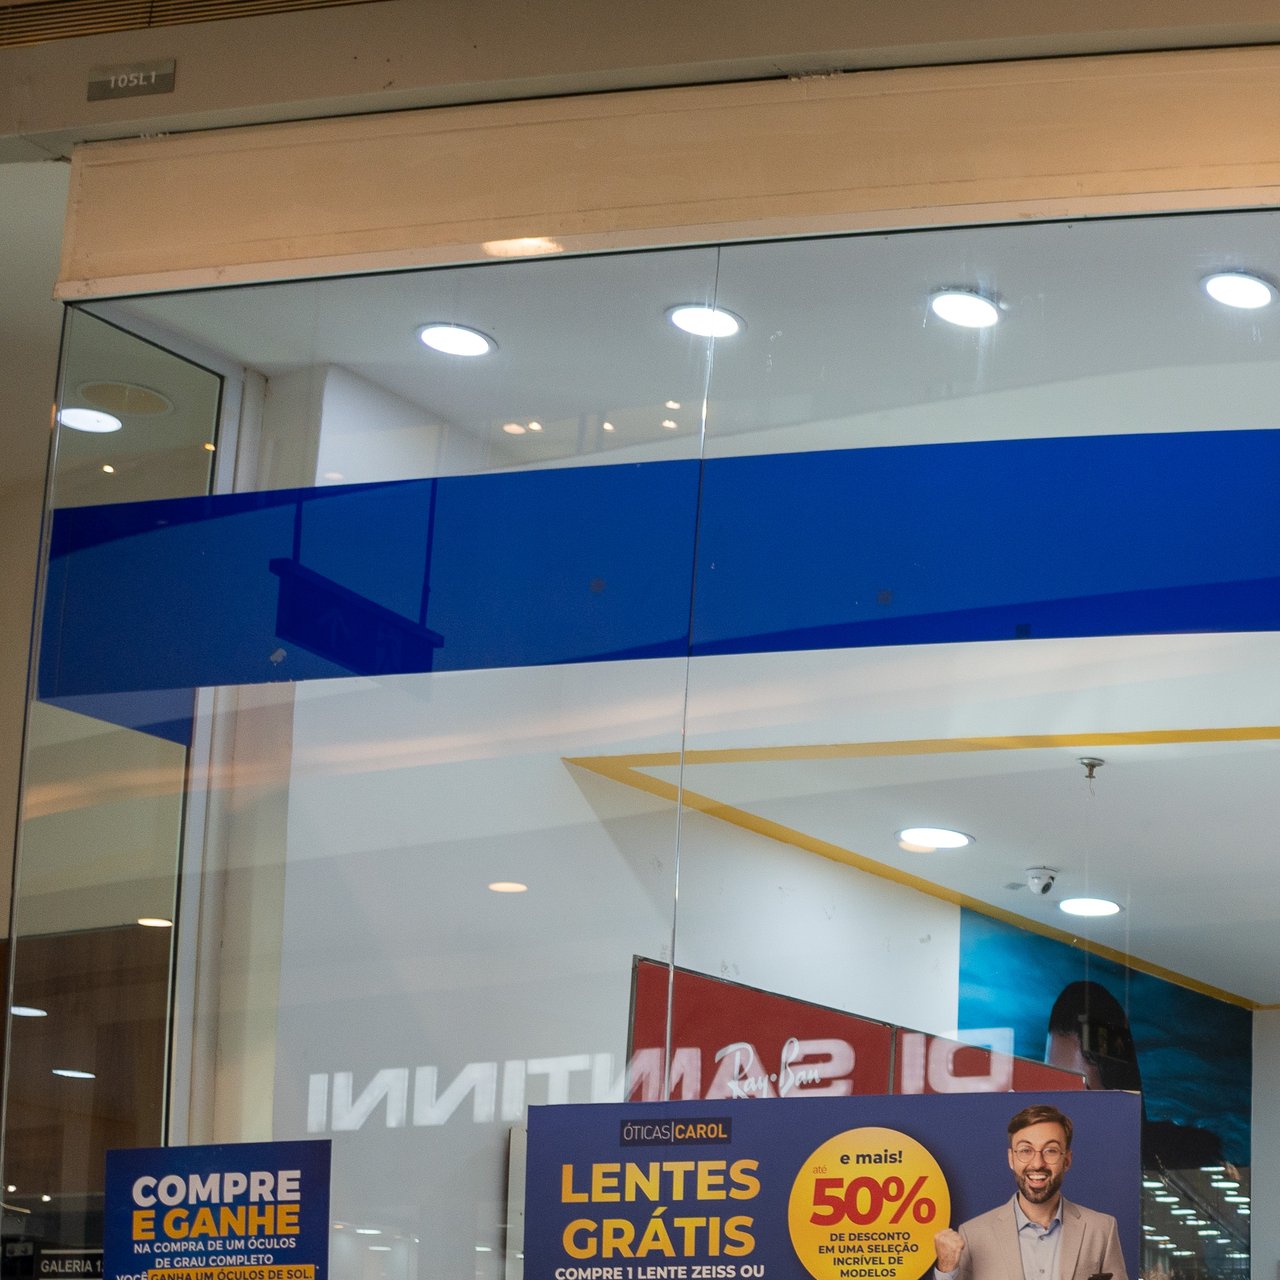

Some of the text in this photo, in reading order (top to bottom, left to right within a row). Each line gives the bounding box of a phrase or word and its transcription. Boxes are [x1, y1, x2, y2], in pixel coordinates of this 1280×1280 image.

[110, 71, 156, 88] 105L1
[675, 1123, 728, 1140] CAROL
[839, 1149, 903, 1165] e mais!
[812, 1165, 827, 1174] até
[132, 1169, 301, 1207] COMPRE
[561, 1159, 761, 1203] LENTES
[809, 1175, 936, 1226] 50%
[132, 1204, 300, 1241] E GANHE
[562, 1206, 756, 1259] GRÁTIS
[829, 1231, 911, 1242] DE DESCONTO
[133, 1235, 296, 1254] NA COMPRA DE UM ÓCULOS
[818, 1241, 919, 1255] EM UMA SELEÇÃO
[40, 1259, 93, 1273] GALERIA
[155, 1254, 274, 1269] DE GRAU COMPLETO
[833, 1255, 904, 1266] INCRÍVEL DE
[268, 1269, 284, 1280] DE
[286, 1268, 313, 1280] SOL.
[555, 1264, 765, 1280] COMPRE 1 LENTE ZEISS OU
[840, 1268, 896, 1278] MODELOS
